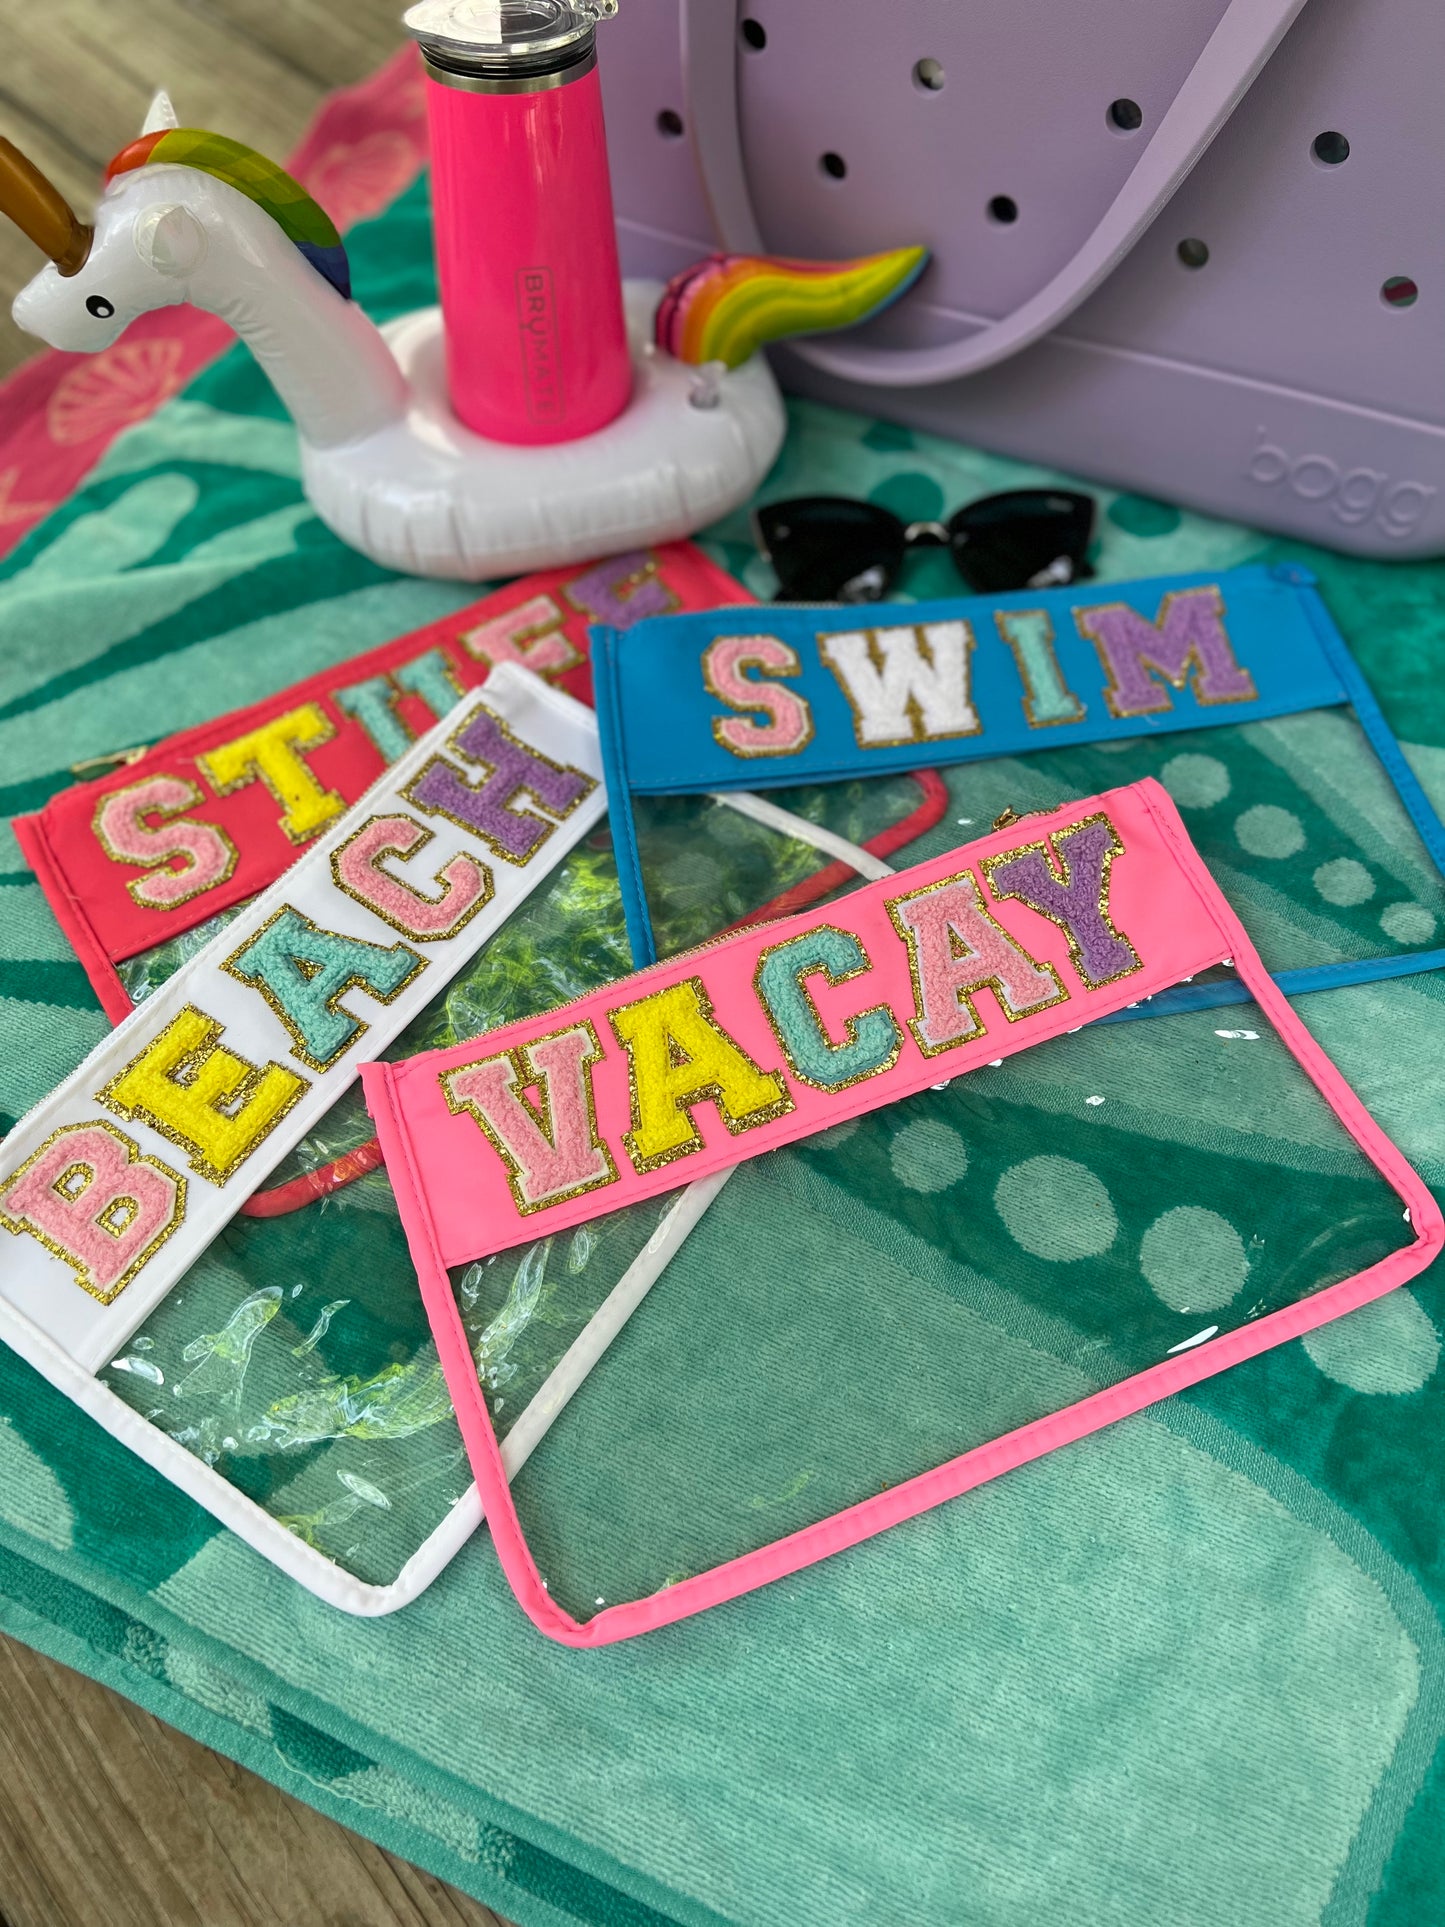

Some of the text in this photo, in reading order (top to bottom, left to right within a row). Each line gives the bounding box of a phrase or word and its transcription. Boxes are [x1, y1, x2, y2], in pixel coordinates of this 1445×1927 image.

[1249, 425, 1437, 539] bogg
[702, 584, 1260, 759] SWIM
[0, 702, 601, 1306] BEACH
[438, 811, 1145, 1217] VACAY
